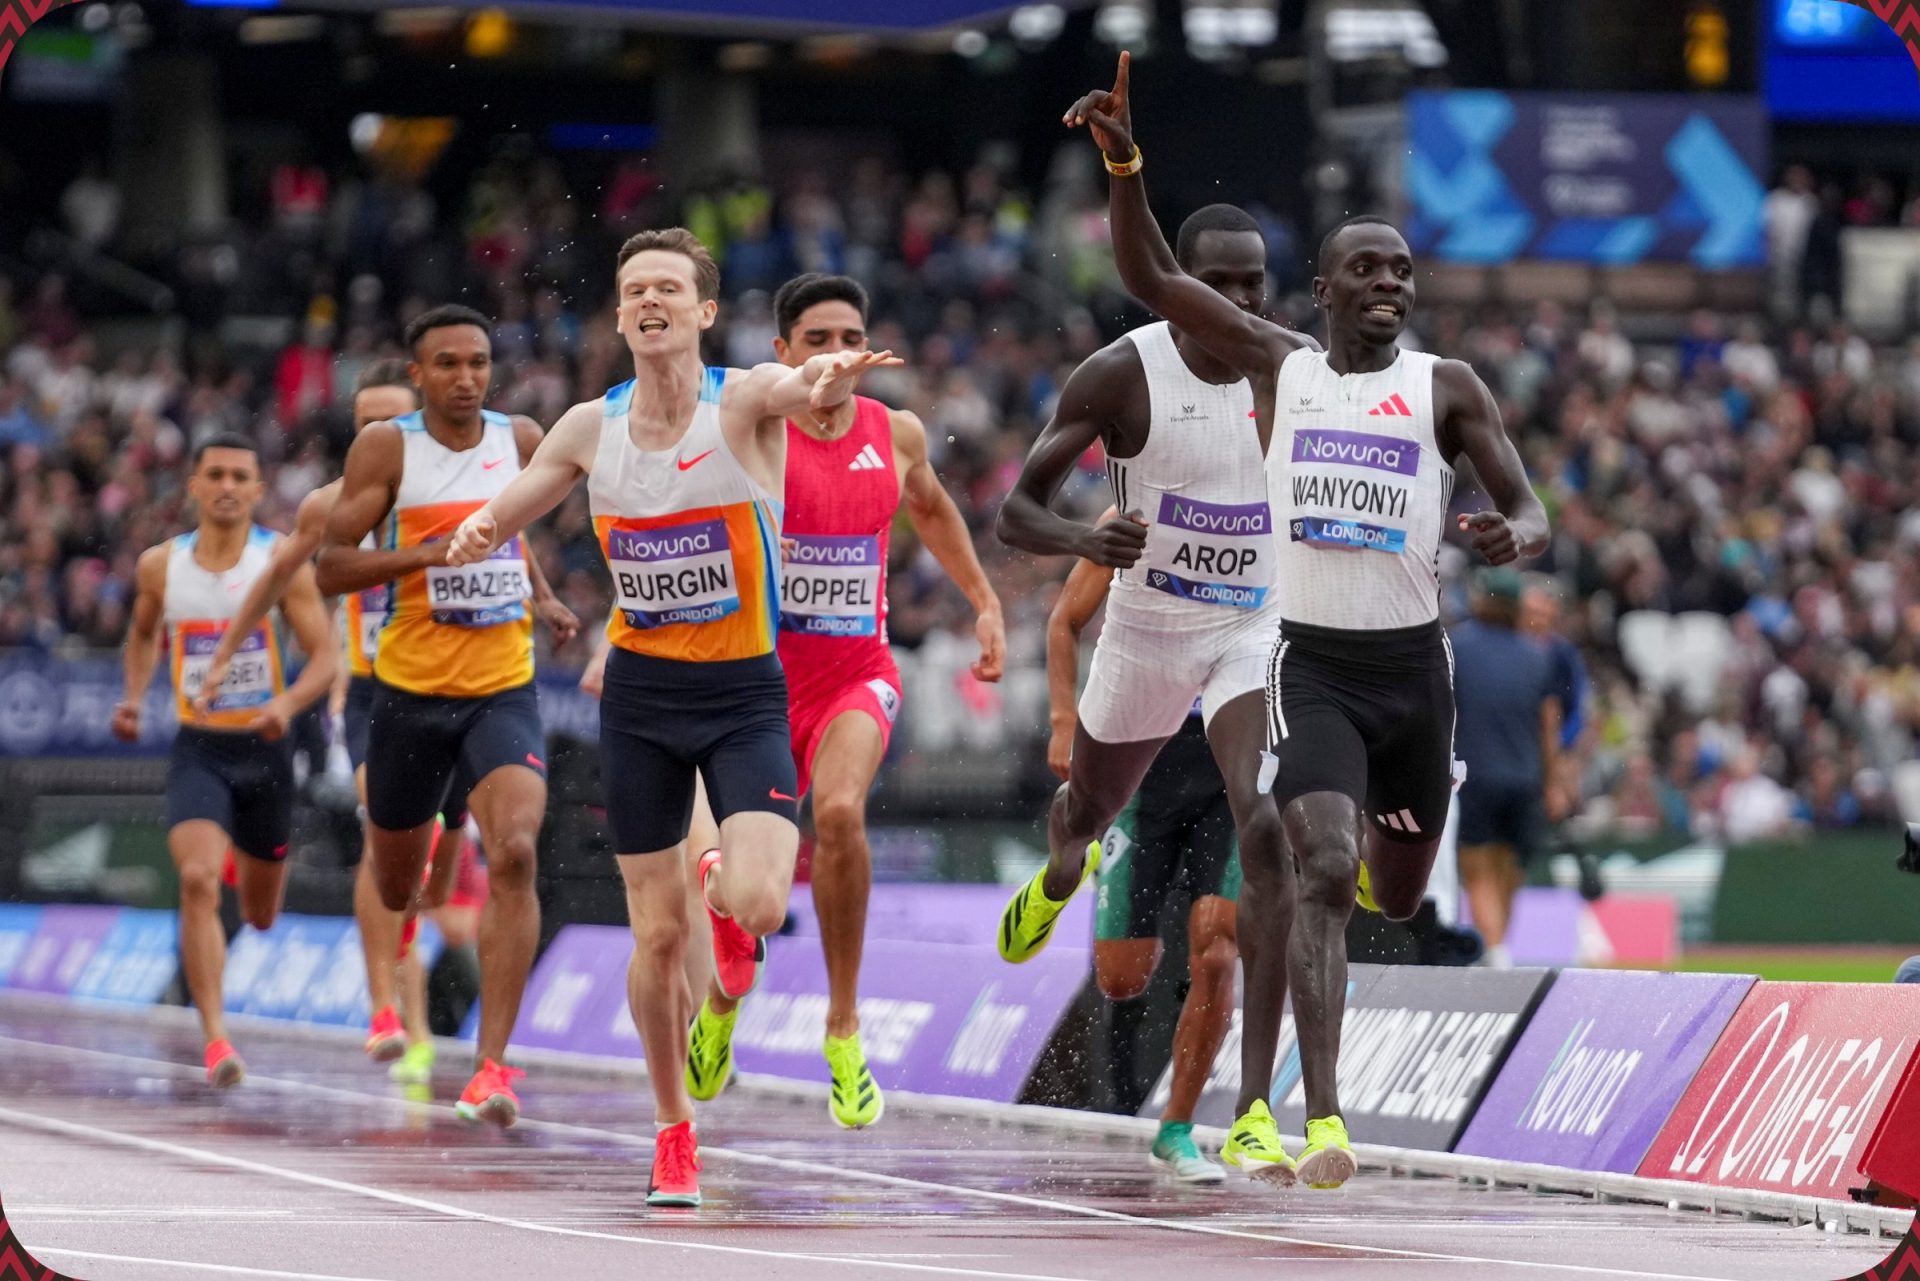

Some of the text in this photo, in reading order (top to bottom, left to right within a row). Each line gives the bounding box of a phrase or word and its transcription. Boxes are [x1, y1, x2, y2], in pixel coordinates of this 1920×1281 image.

[1303, 435, 1400, 468] Novuna
[1292, 475, 1407, 518] WANYONYI
[1172, 503, 1265, 532] Novuna
[617, 533, 711, 558] Novuna
[1322, 523, 1388, 545] LONDON
[1171, 542, 1257, 577] AROP
[433, 571, 529, 602] BRAZIER
[618, 563, 728, 602] BURGIN
[1191, 585, 1256, 603] LONDON
[660, 604, 724, 625] LONDON
[806, 618, 862, 632] LONDON
[1106, 833, 1116, 857] 6
[1378, 1010, 1519, 1122] LEAGUE
[1718, 1033, 1903, 1188] OMEGA
